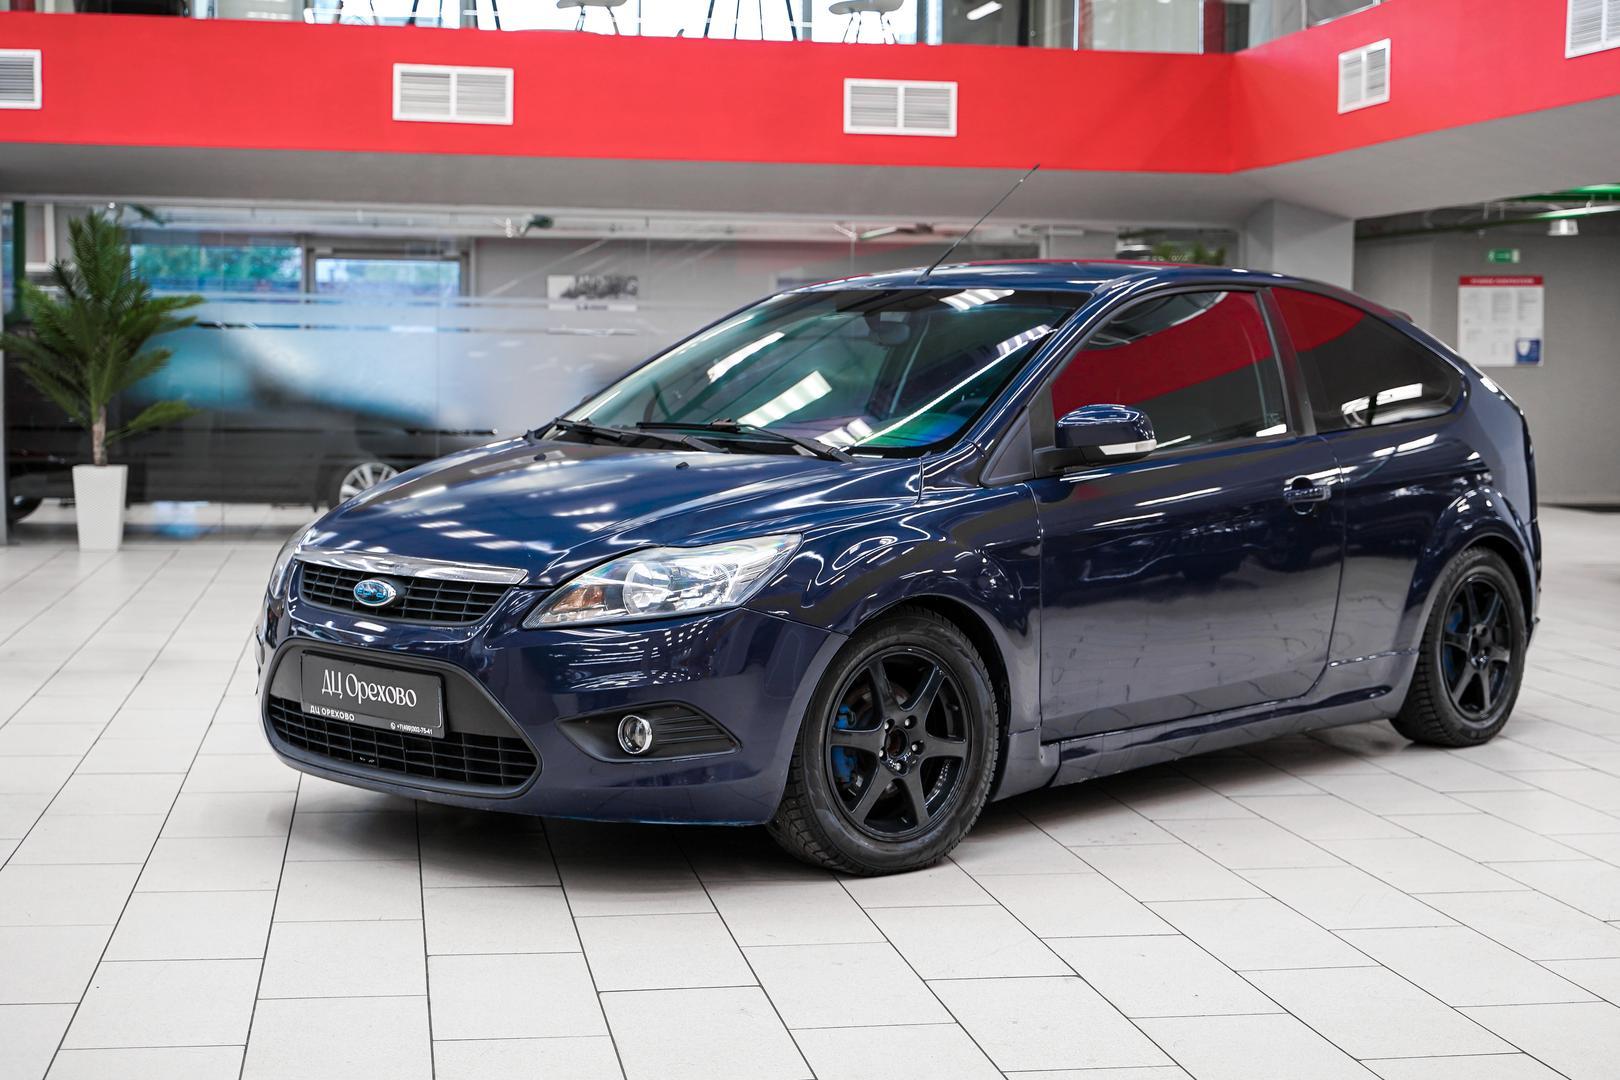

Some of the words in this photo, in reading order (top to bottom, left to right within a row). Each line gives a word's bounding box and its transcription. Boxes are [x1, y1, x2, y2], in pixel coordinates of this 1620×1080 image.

[322, 669, 343, 699] ДЦ
[345, 673, 417, 707] Орехово
[310, 705, 321, 715] ДЦ
[321, 707, 355, 721] ОРЕХОВО
